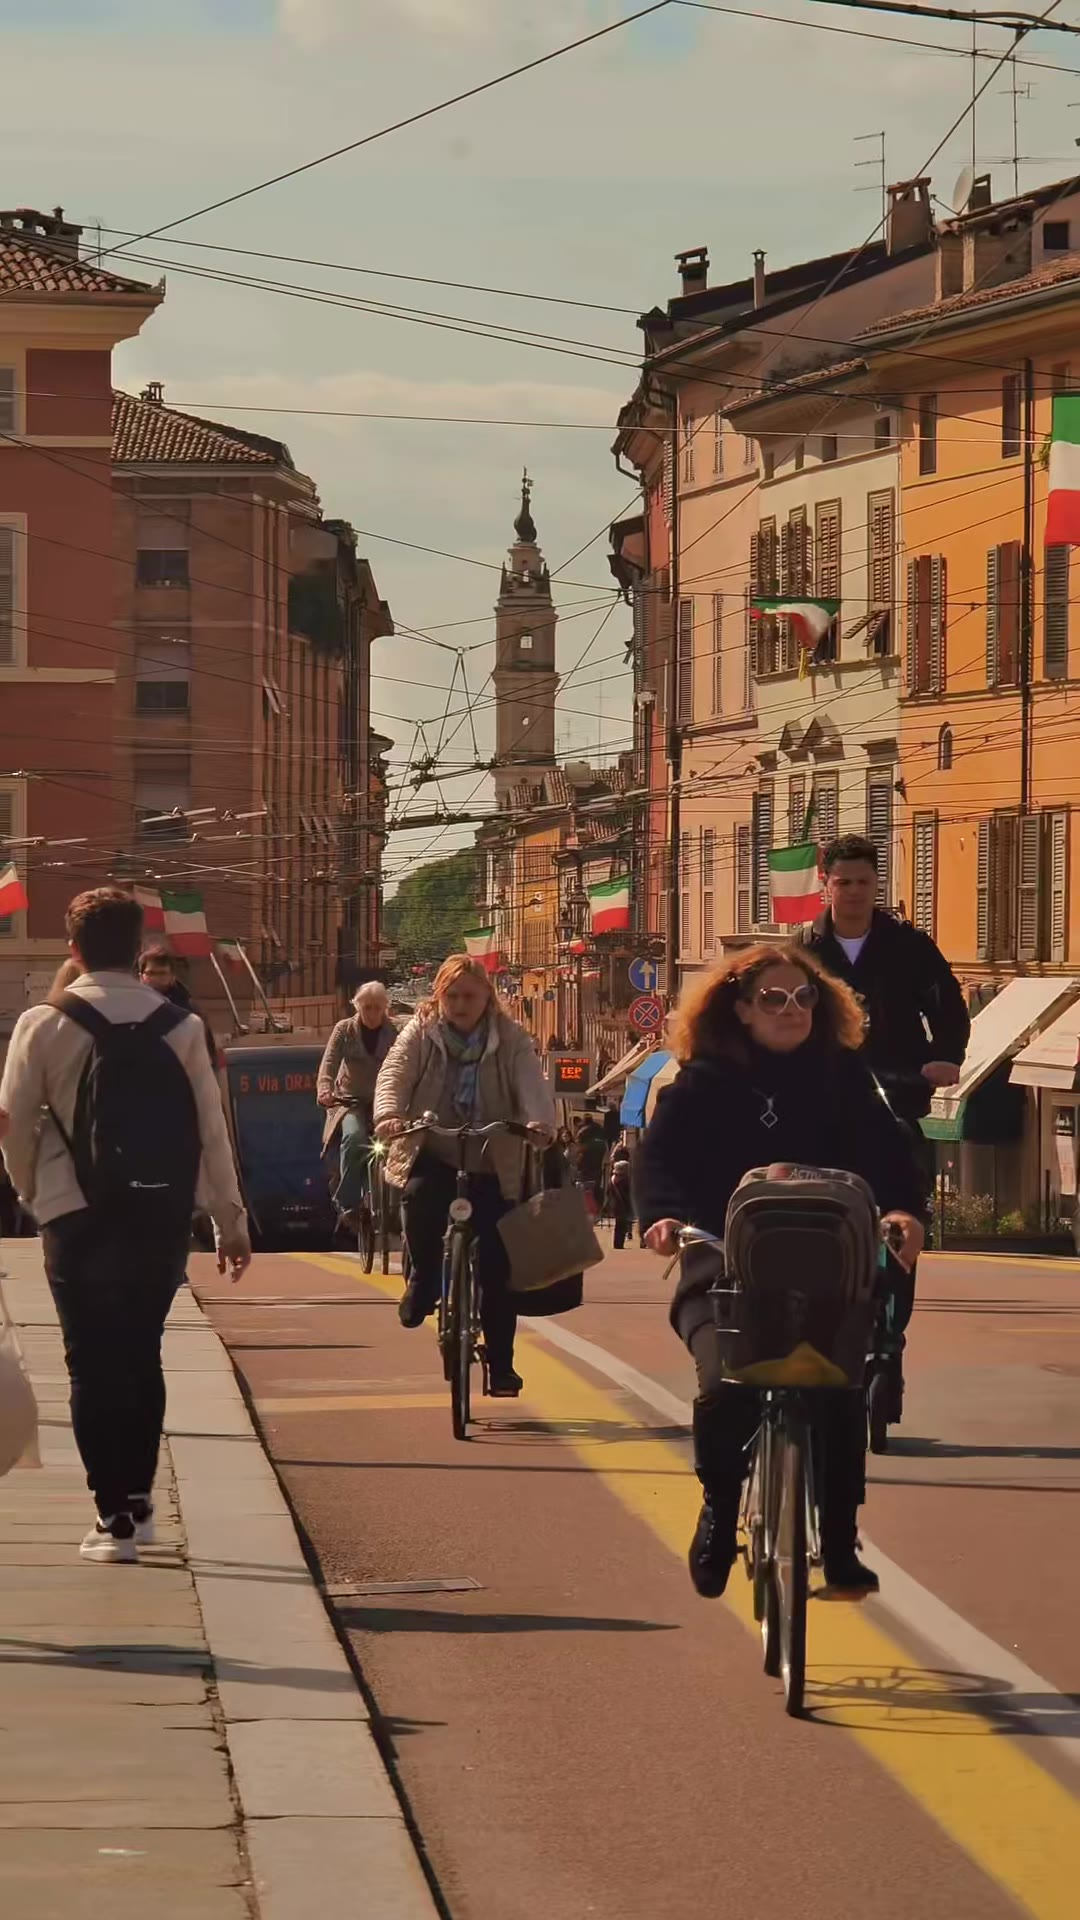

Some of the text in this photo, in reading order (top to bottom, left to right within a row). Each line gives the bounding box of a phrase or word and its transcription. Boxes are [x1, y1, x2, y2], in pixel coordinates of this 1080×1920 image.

[560, 1066, 582, 1074] TEP
[257, 1073, 279, 1092] Via
[285, 1072, 316, 1091] ORA
